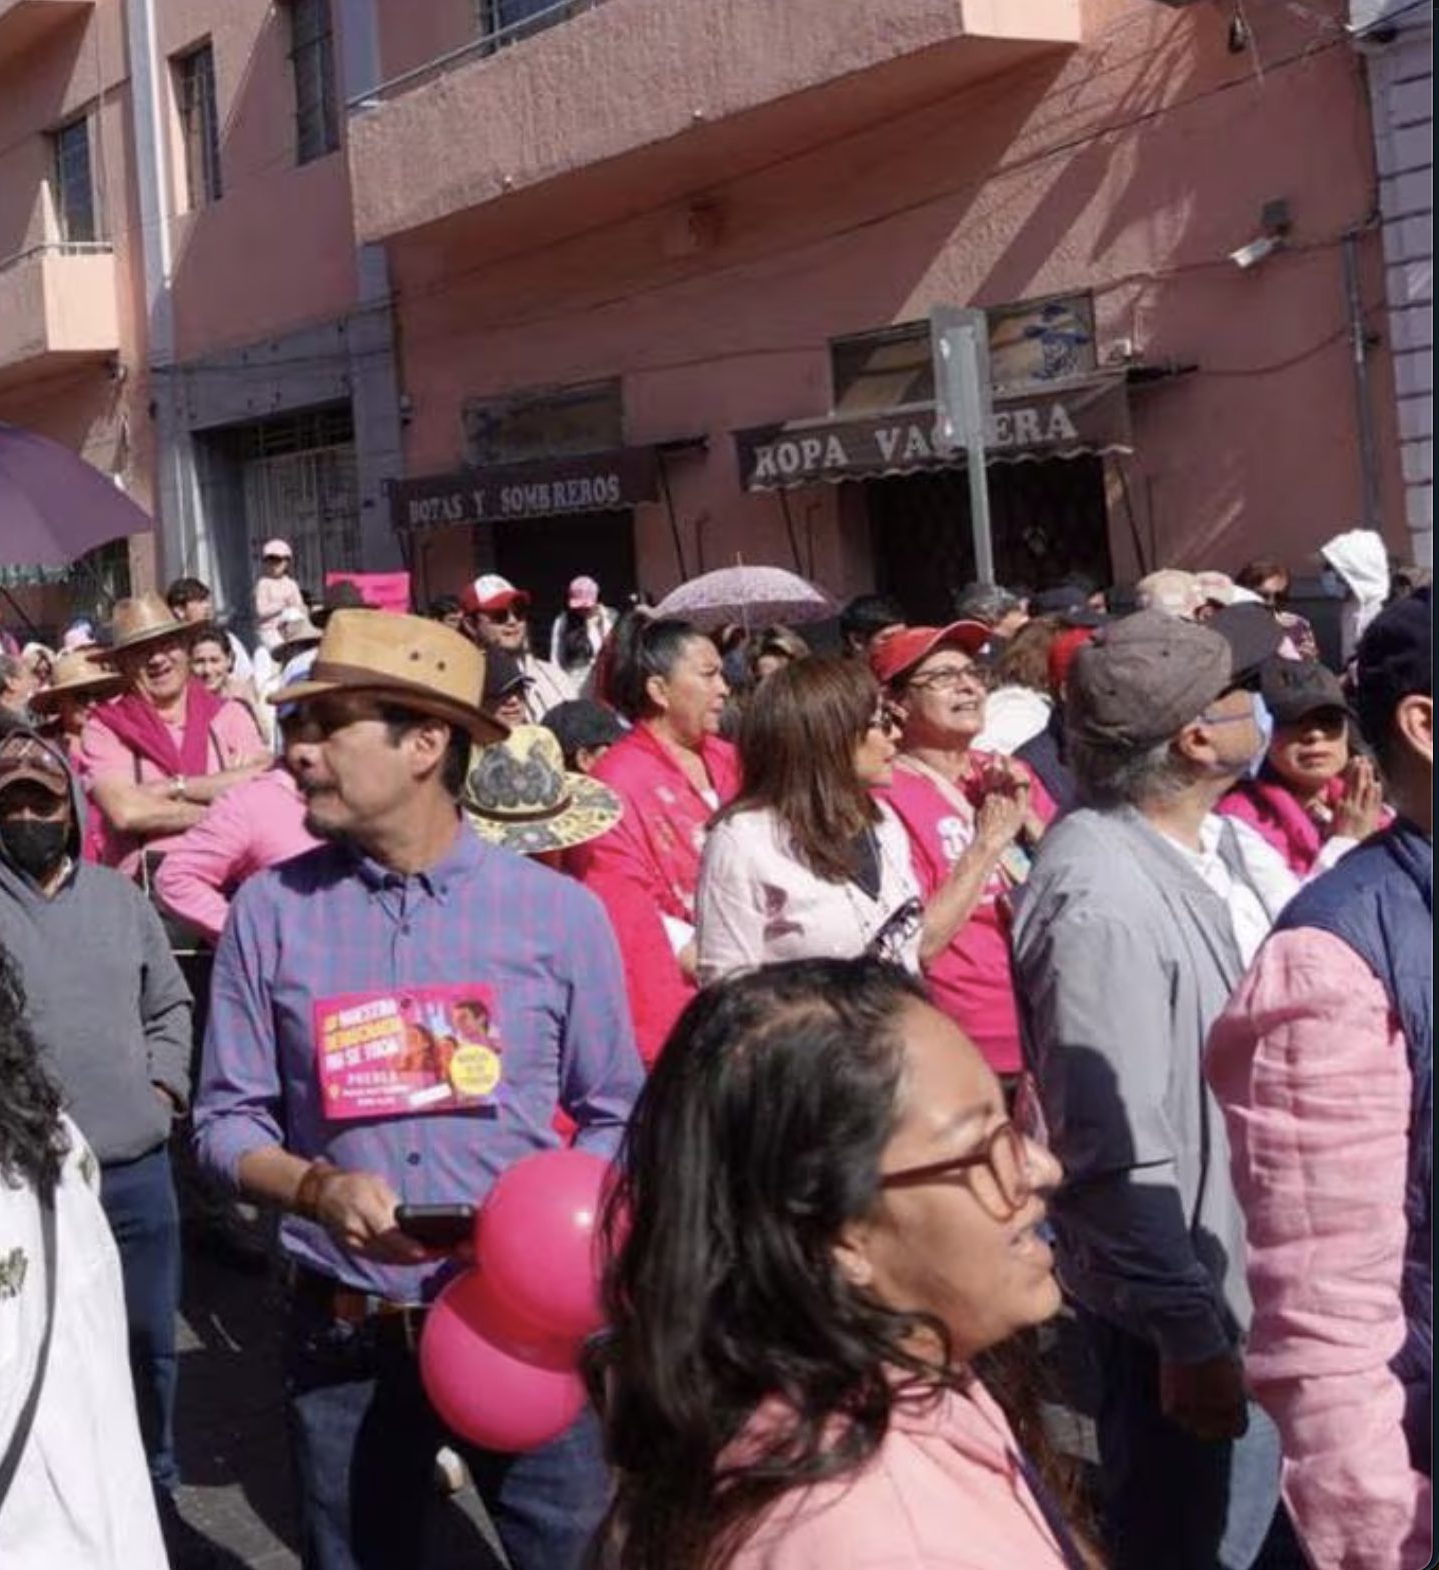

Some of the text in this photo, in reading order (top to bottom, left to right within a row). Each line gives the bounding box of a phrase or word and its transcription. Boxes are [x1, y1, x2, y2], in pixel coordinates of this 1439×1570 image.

[754, 403, 1078, 477] ROPA VAQERA
[409, 475, 621, 522] BOTAS Y SOMBREROS
